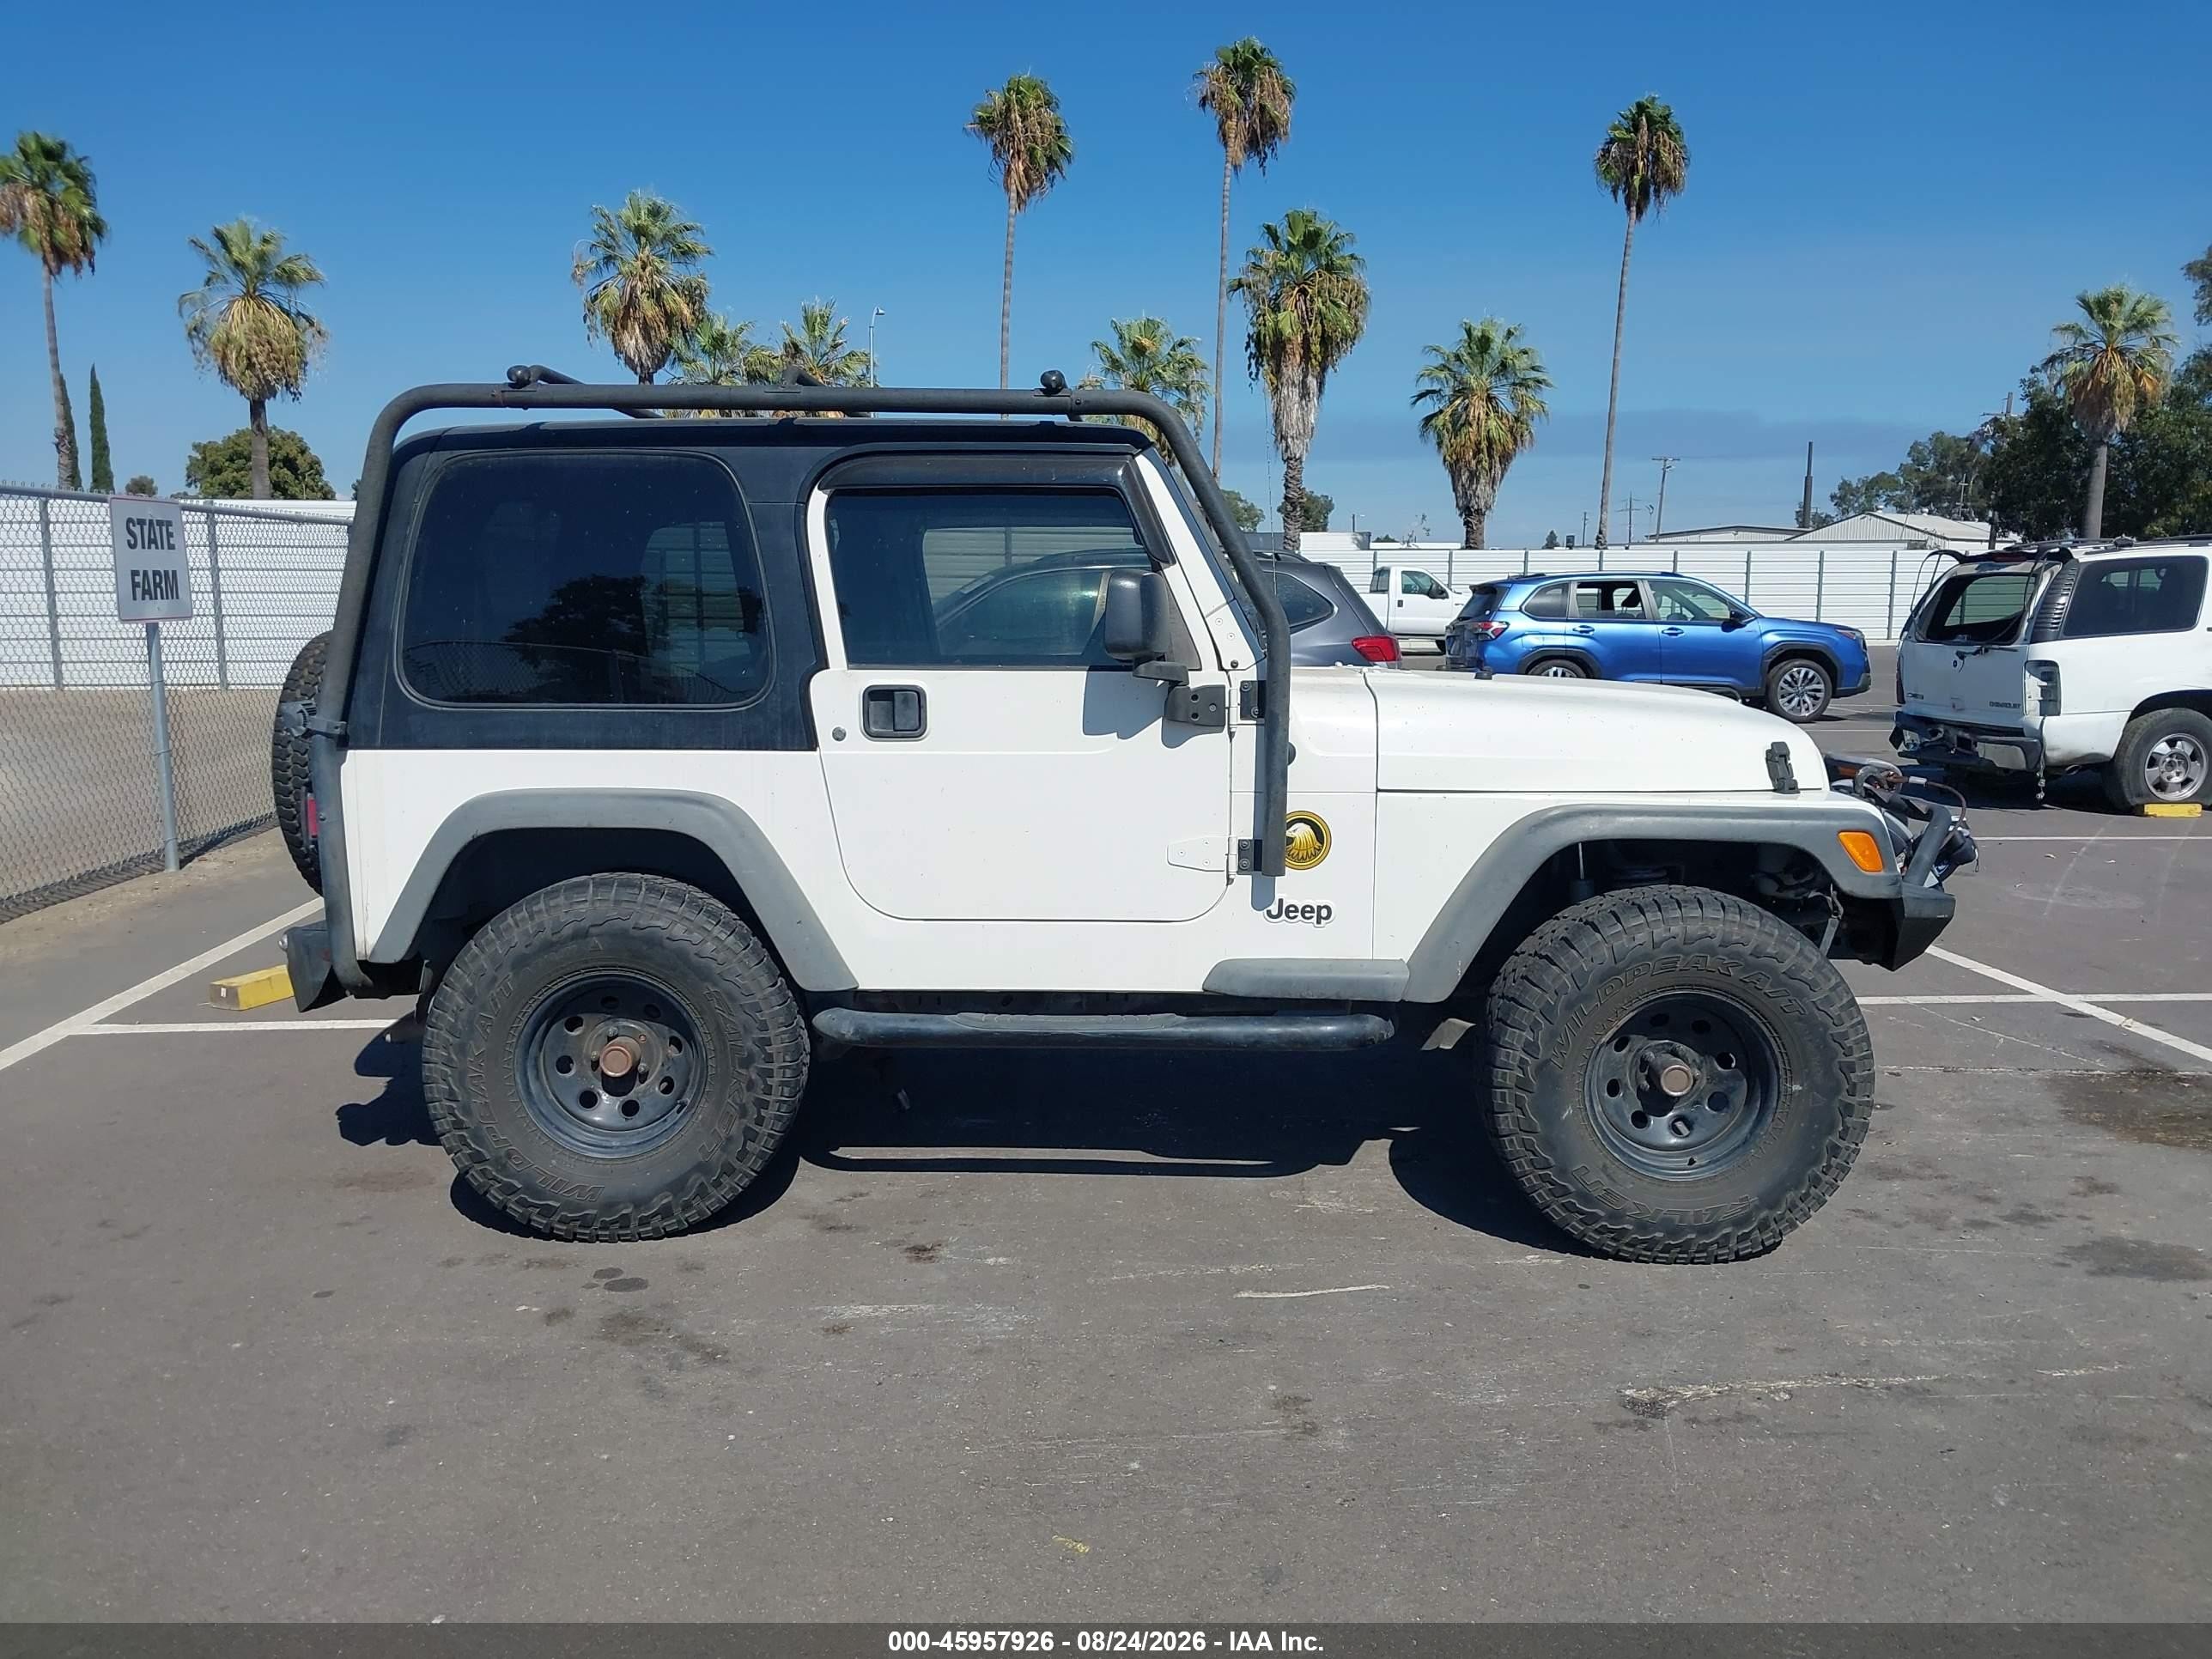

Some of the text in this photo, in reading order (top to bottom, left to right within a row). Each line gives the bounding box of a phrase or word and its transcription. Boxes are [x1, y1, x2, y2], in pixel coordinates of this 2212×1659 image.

[125, 517, 176, 550] STATE
[131, 569, 179, 601] FARM
[1266, 898, 1333, 925] Jeep
[1550, 954, 1808, 1070] WILDPEAK A/T
[697, 985, 749, 1163] FALKEN
[468, 1048, 605, 1202] WILDPEAK
[1572, 1164, 1759, 1226] FALKEN
